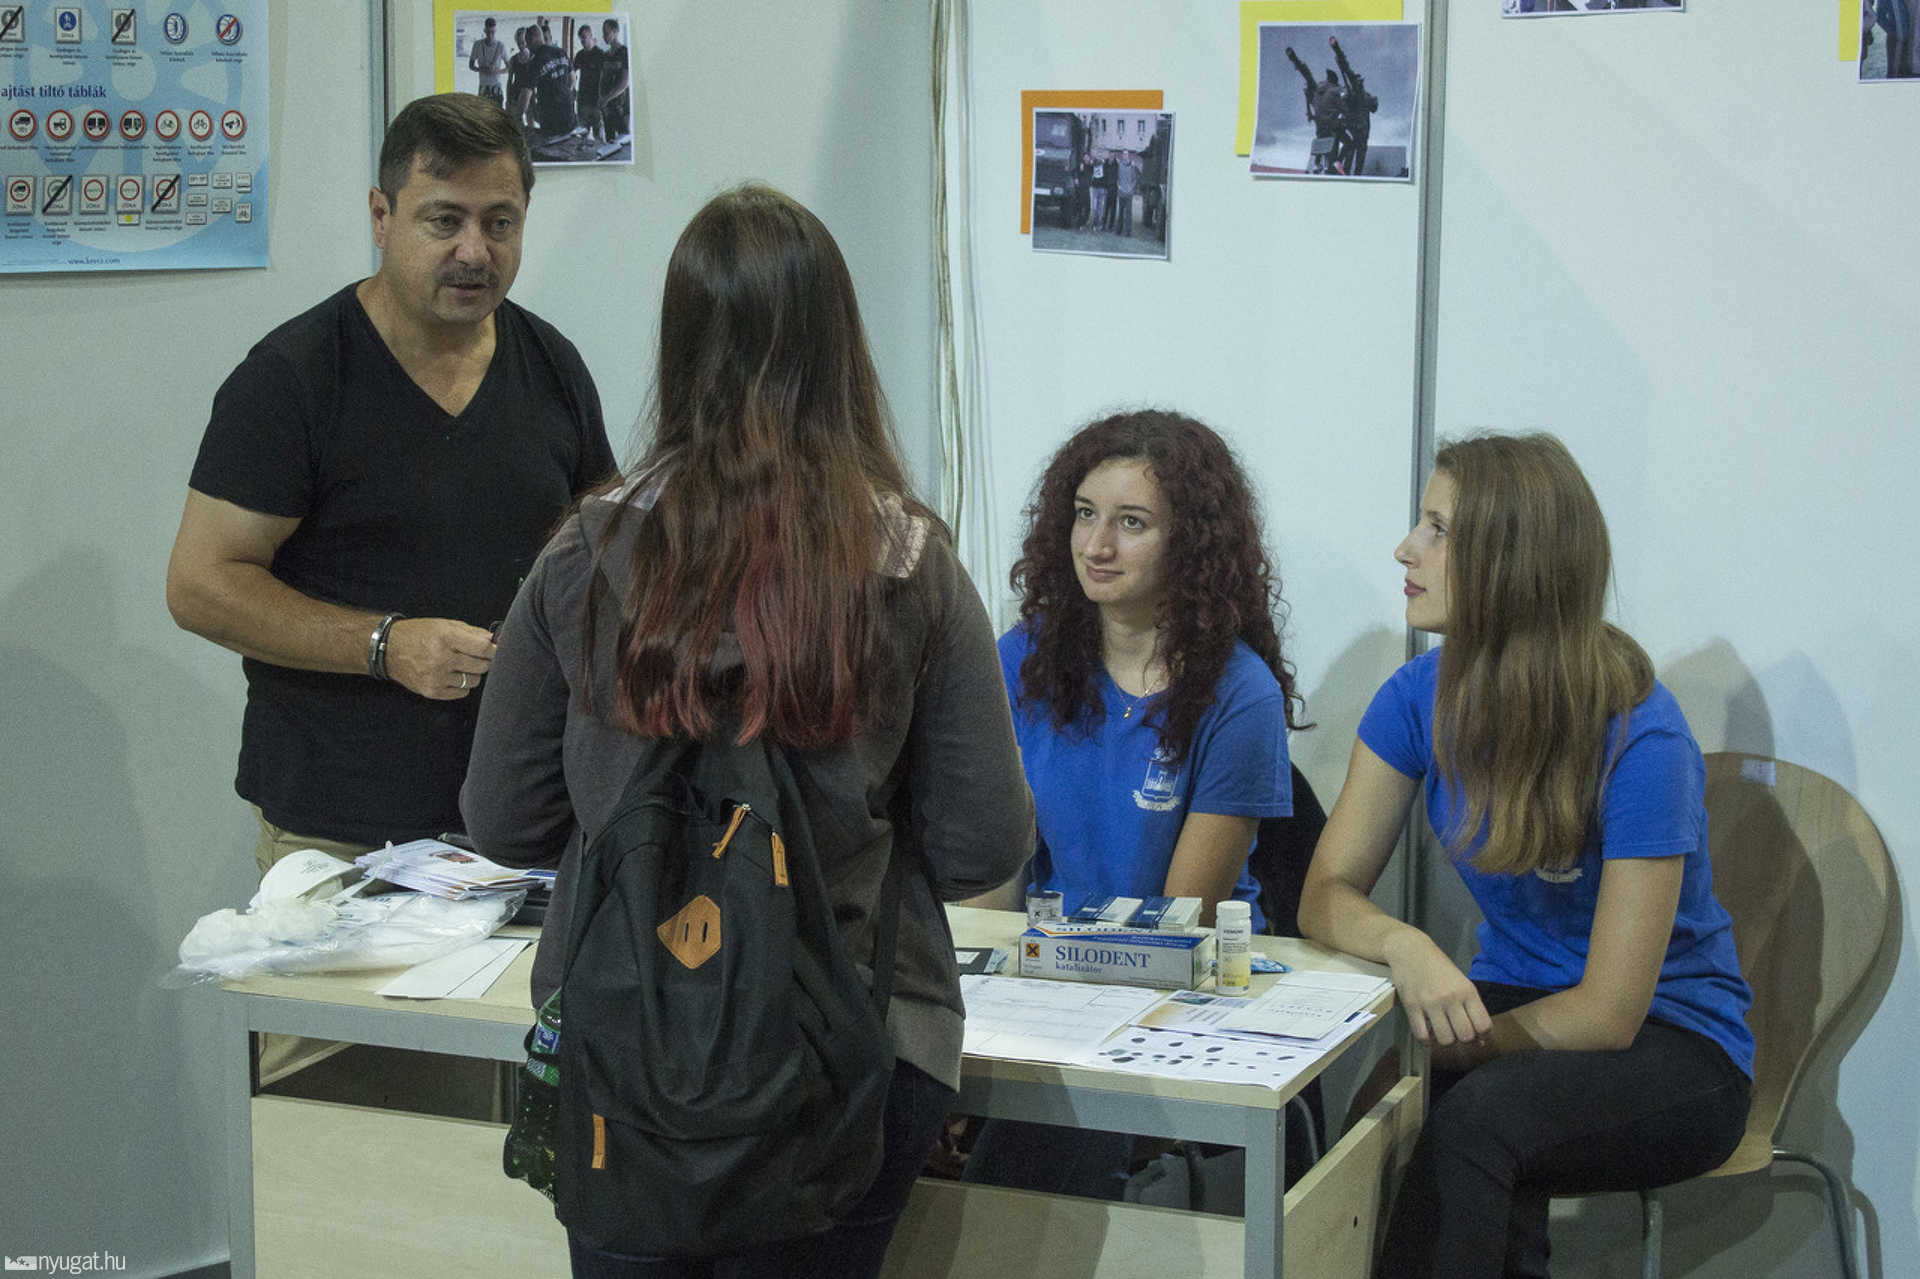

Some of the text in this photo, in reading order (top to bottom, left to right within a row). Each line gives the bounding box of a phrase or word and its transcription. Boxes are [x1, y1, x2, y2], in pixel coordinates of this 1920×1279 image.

[39, 85, 65, 98] tiltó
[68, 84, 107, 98] táblák
[1056, 945, 1151, 968] SILODENT
[1056, 961, 1103, 974] katalizátor
